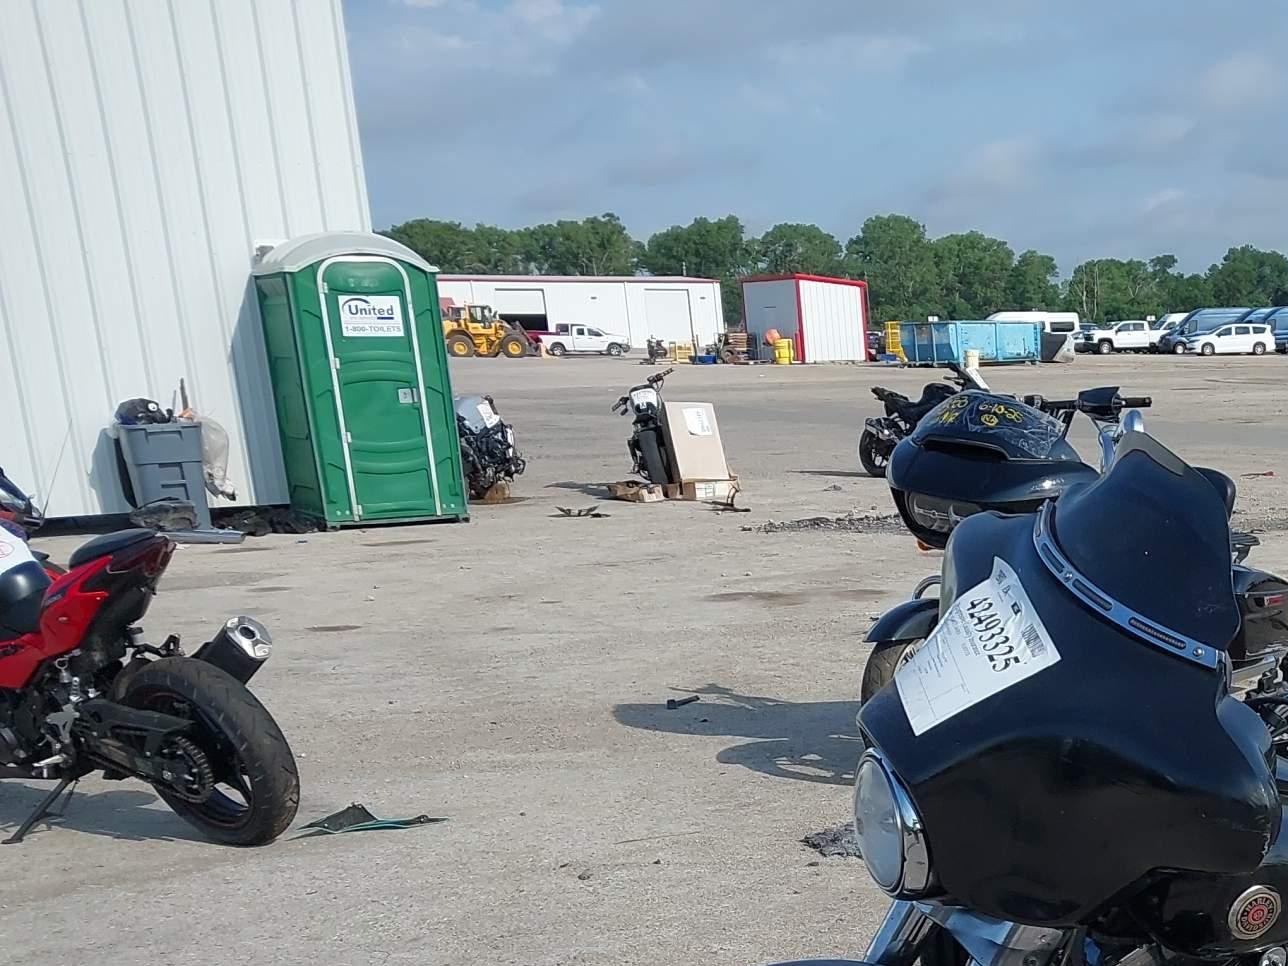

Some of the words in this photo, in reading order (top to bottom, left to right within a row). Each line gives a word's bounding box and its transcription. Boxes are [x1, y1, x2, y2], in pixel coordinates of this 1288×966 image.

[348, 304, 394, 316] United
[345, 325, 401, 333] 1-800-TOILETS
[966, 597, 1020, 673] 42493325
[1245, 897, 1273, 911] HARLEY
